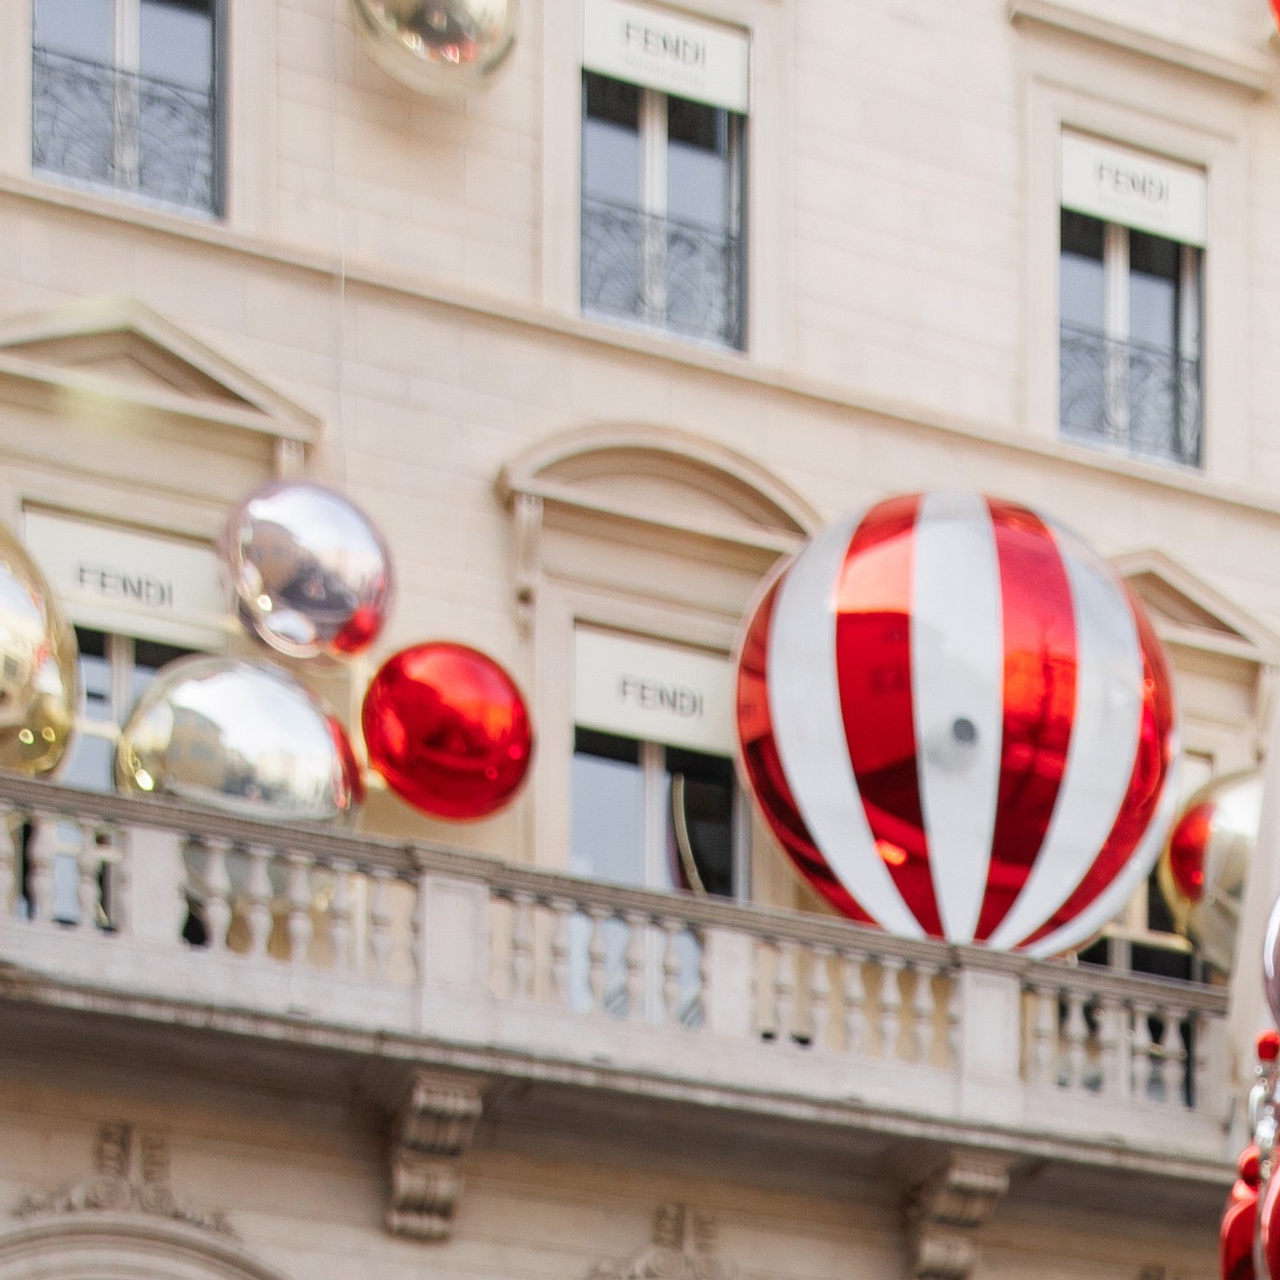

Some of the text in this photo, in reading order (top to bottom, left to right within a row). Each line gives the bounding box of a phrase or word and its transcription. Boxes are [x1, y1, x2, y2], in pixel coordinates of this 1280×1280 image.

[624, 20, 706, 69] FENDI
[1096, 162, 1170, 206] FENDI
[77, 564, 173, 608] FENDI
[619, 675, 704, 718] FENDI
